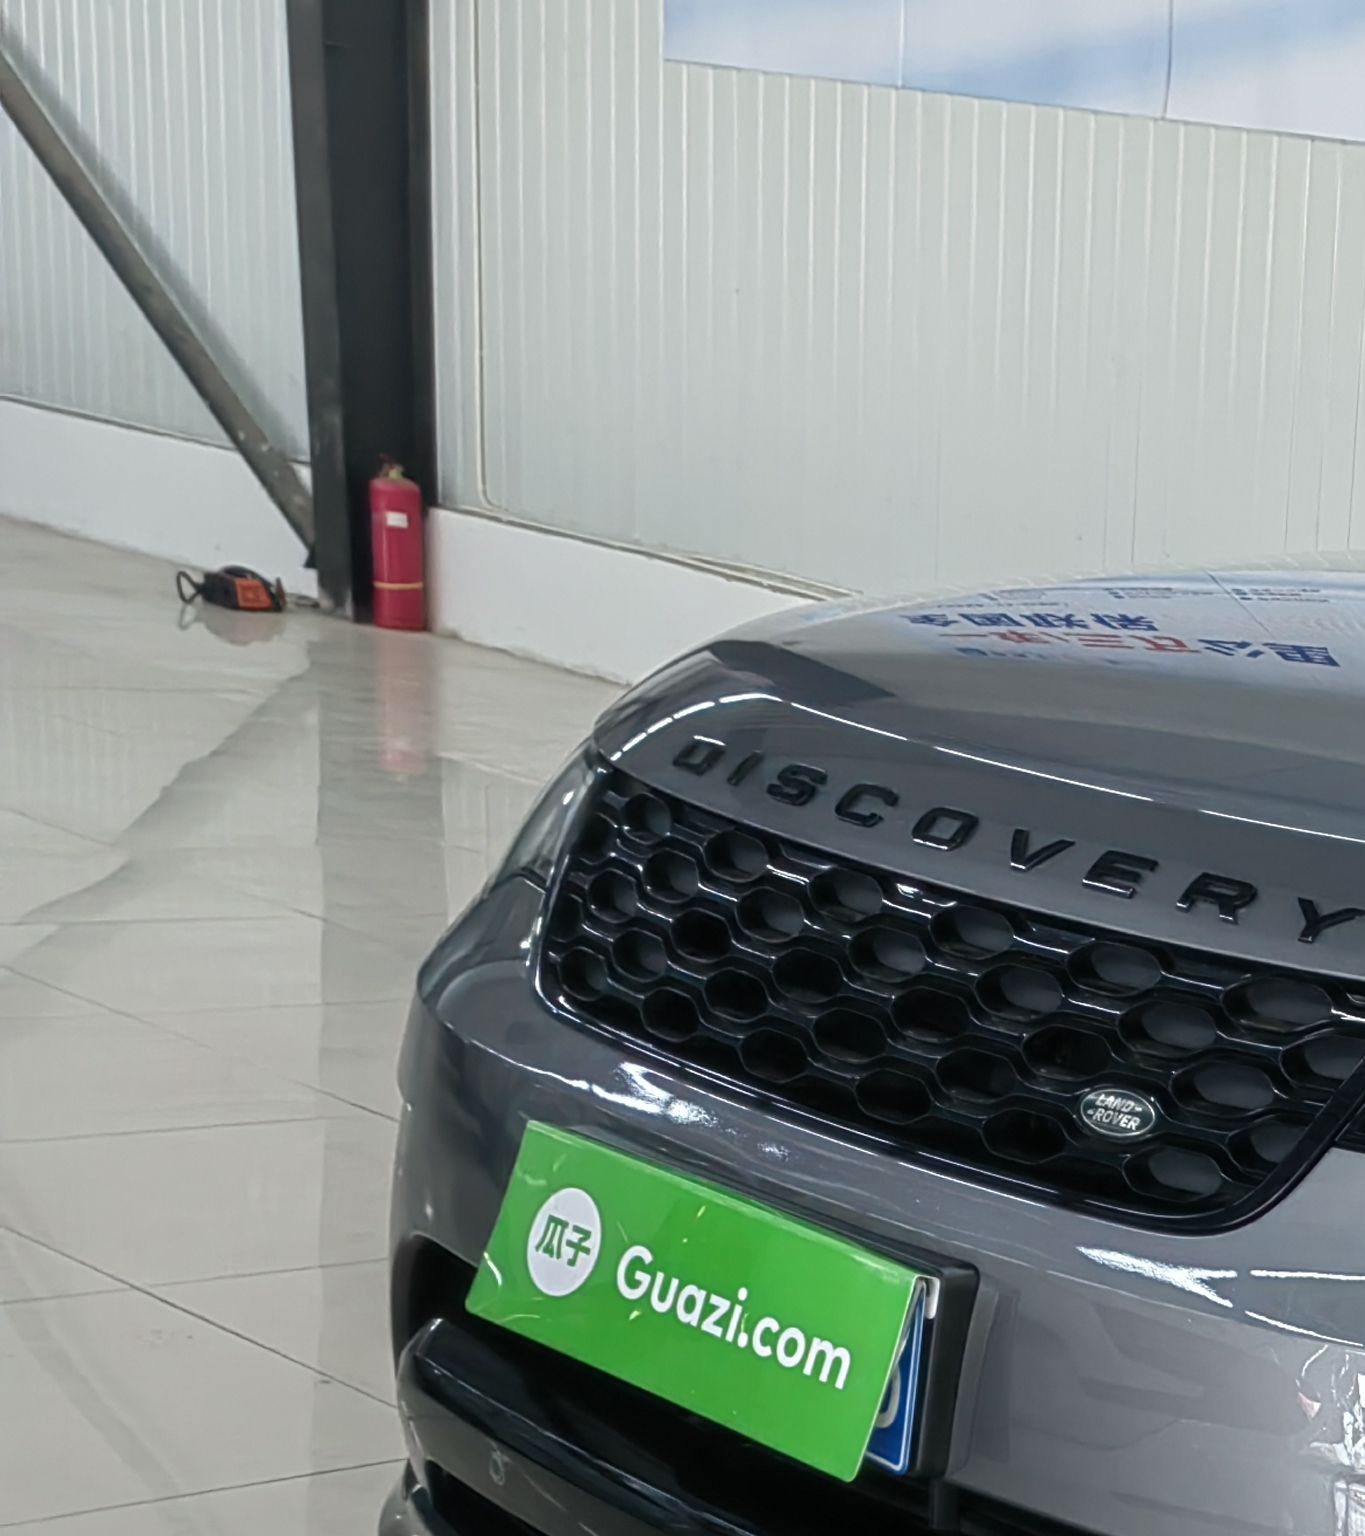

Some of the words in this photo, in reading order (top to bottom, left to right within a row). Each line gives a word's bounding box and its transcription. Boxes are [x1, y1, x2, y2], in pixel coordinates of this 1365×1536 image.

[1093, 1108, 1141, 1130] ROVER
[1095, 1093, 1136, 1112] LAND
[534, 1214, 592, 1267] 瓜子
[615, 1244, 852, 1390] Guazi.com
